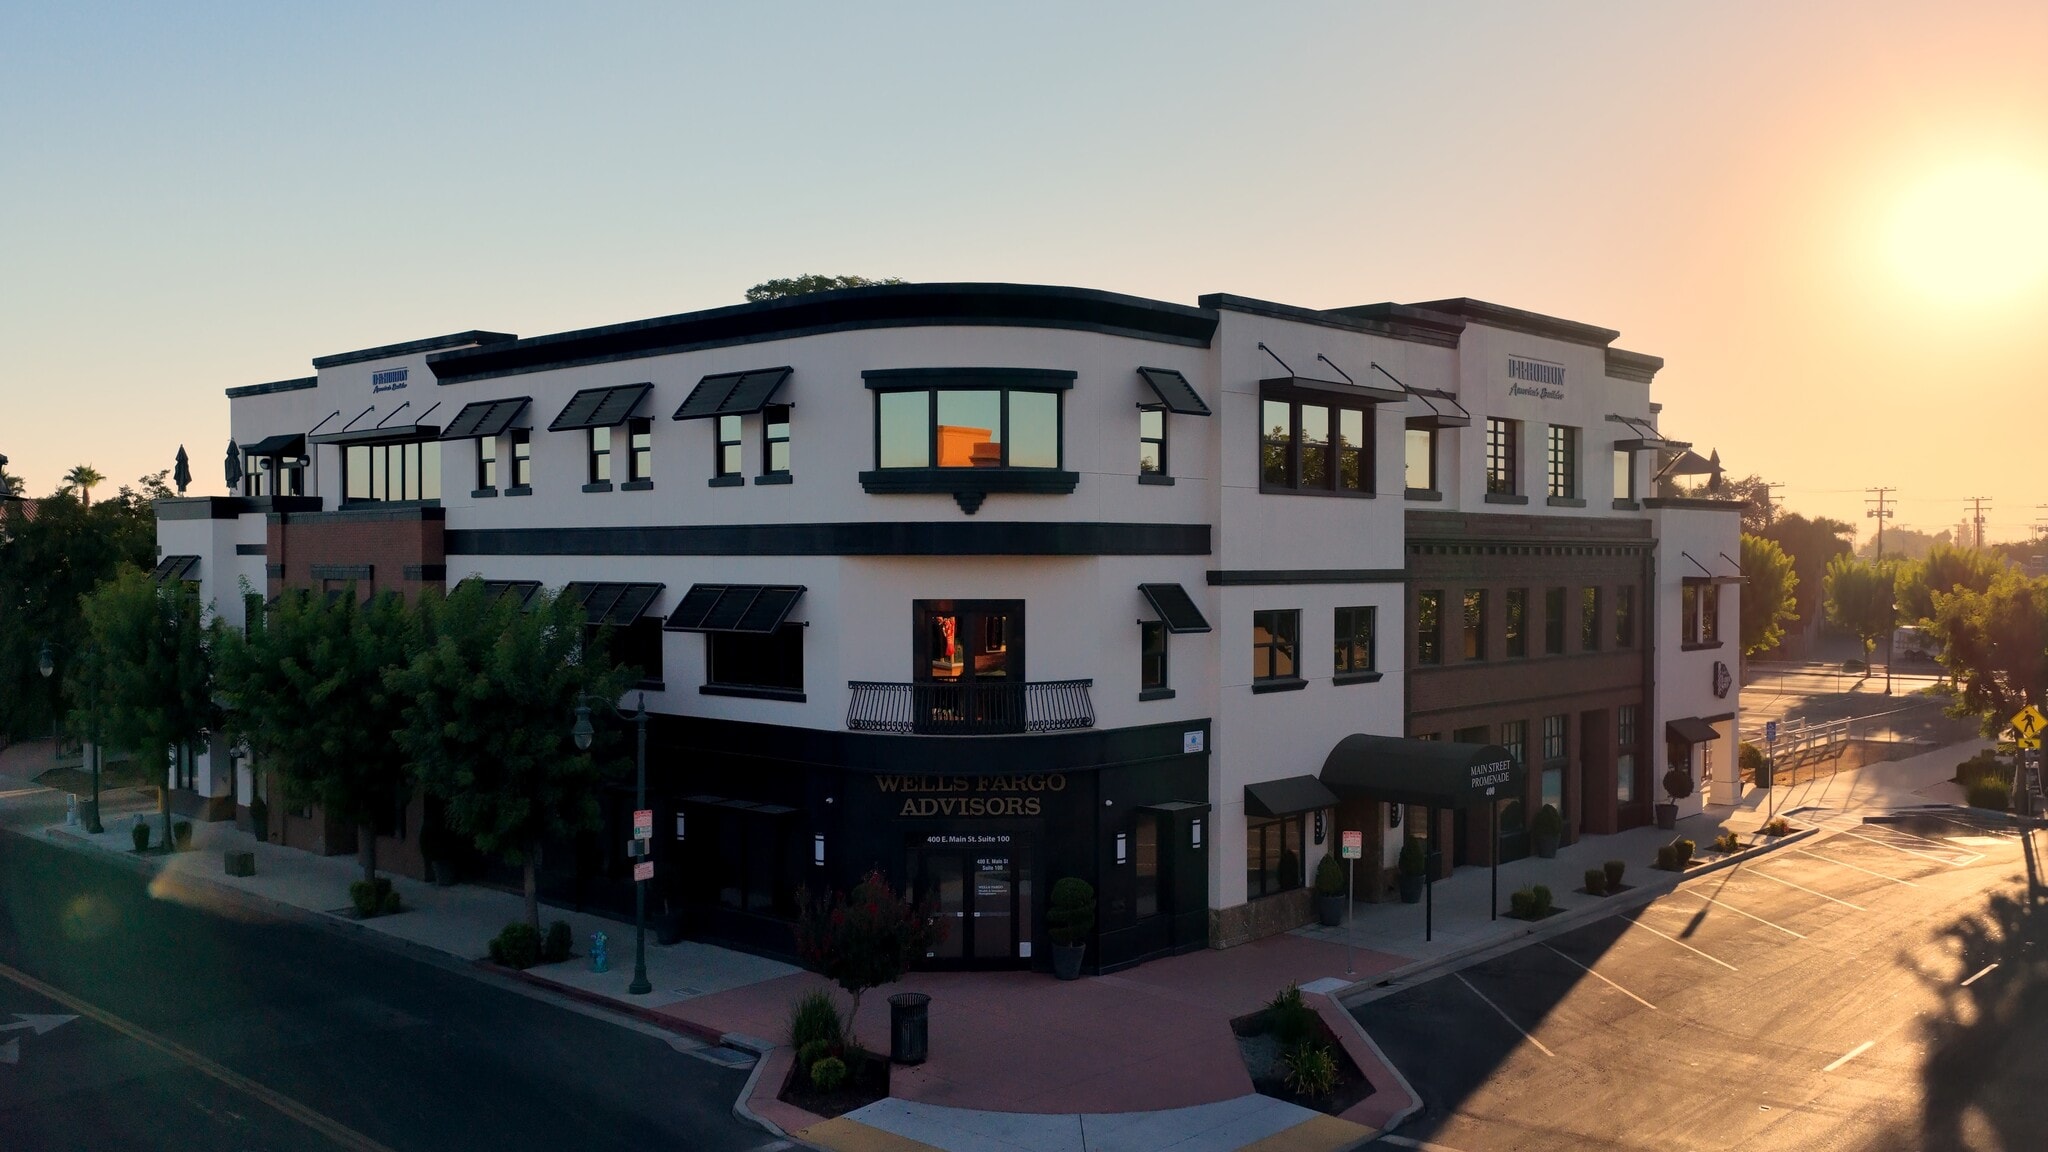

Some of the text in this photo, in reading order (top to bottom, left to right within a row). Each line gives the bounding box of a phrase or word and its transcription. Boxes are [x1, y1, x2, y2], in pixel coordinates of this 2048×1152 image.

[1470, 760, 1511, 776] MAIN STREET
[876, 774, 1066, 792] WELLS FARGO
[1471, 772, 1510, 788] PROMENADE
[1486, 786, 1495, 796] 400
[899, 797, 1041, 816] ADVISORS
[977, 835, 996, 843] Suite
